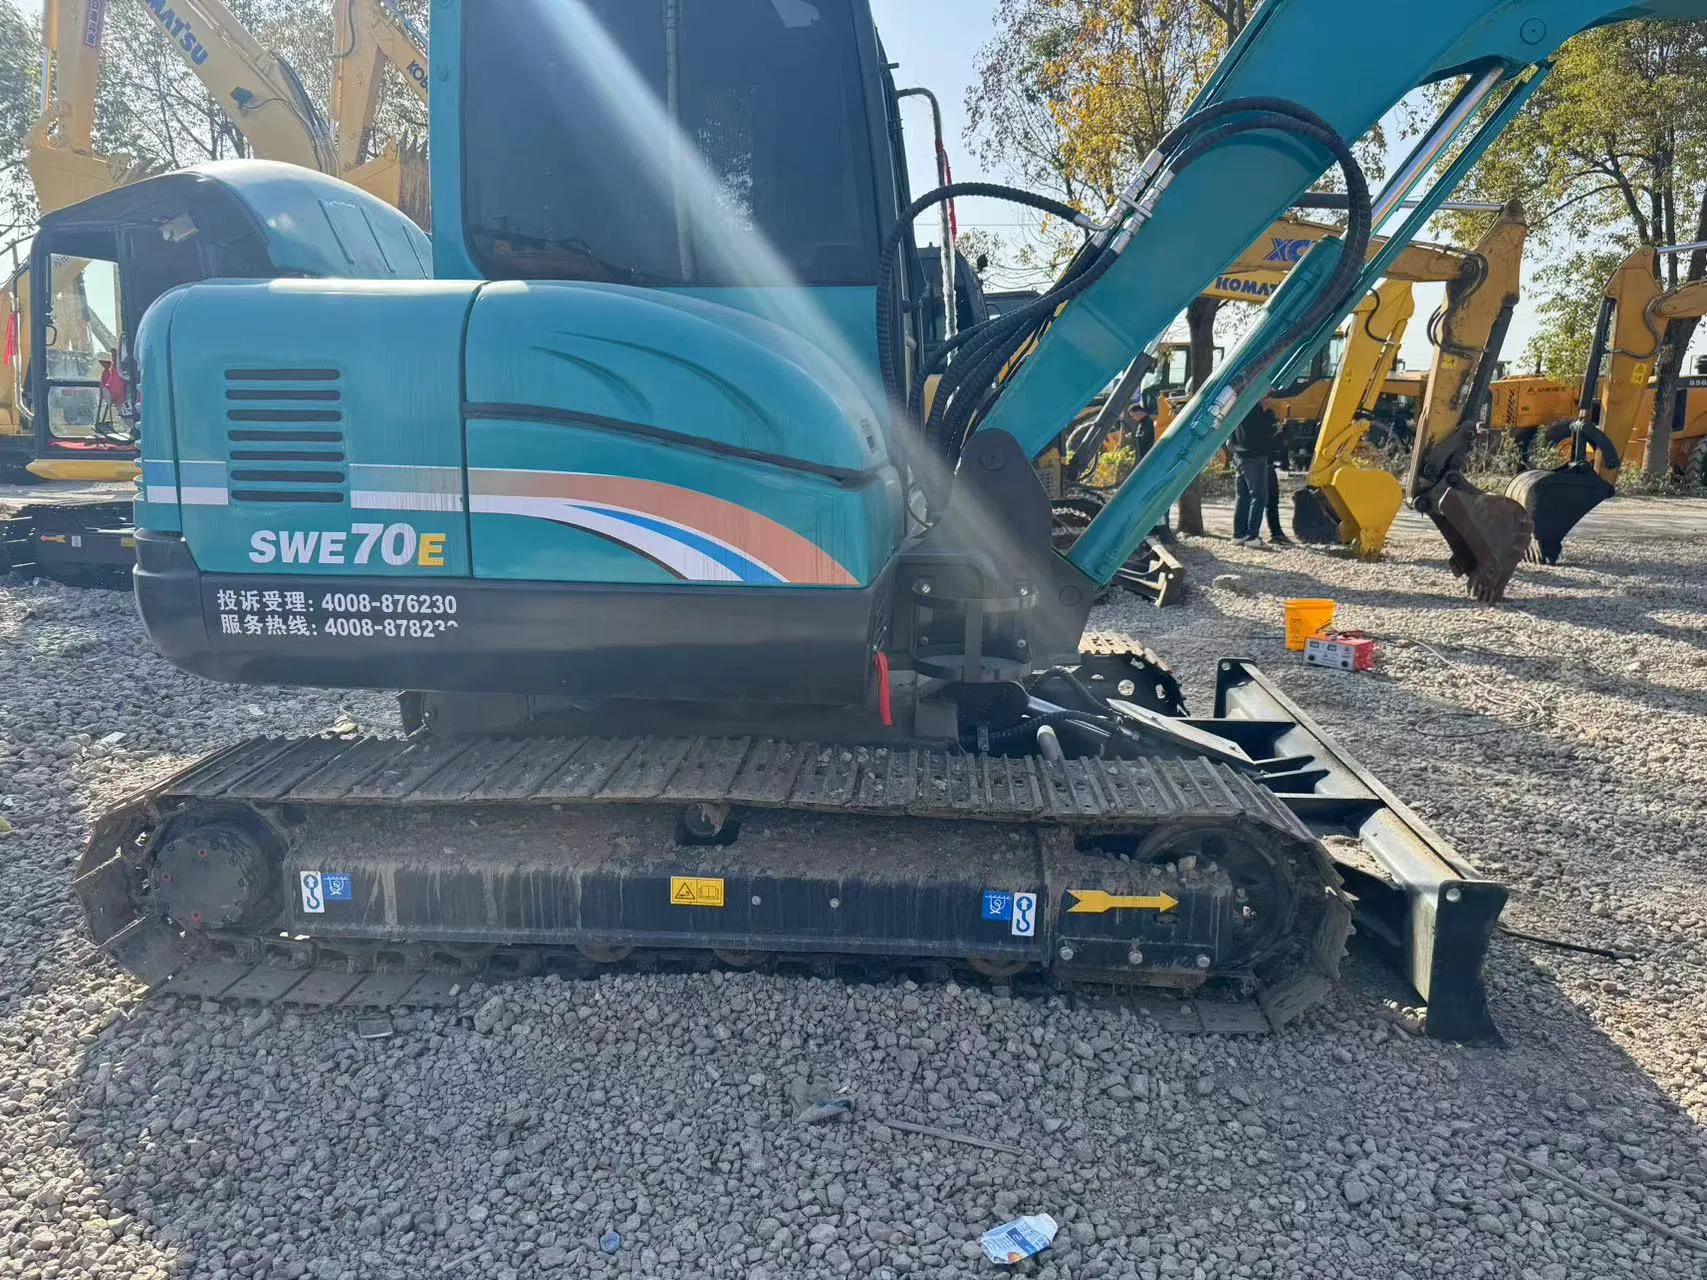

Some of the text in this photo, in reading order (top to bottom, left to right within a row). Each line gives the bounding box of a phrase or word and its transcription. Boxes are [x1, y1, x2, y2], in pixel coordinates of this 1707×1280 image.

[406, 60, 430, 92] KOB
[248, 522, 447, 566] SWE70E
[216, 589, 457, 614] 投诉受理： 4008-876230
[220, 613, 459, 638] 服务热线： 4008-87823
